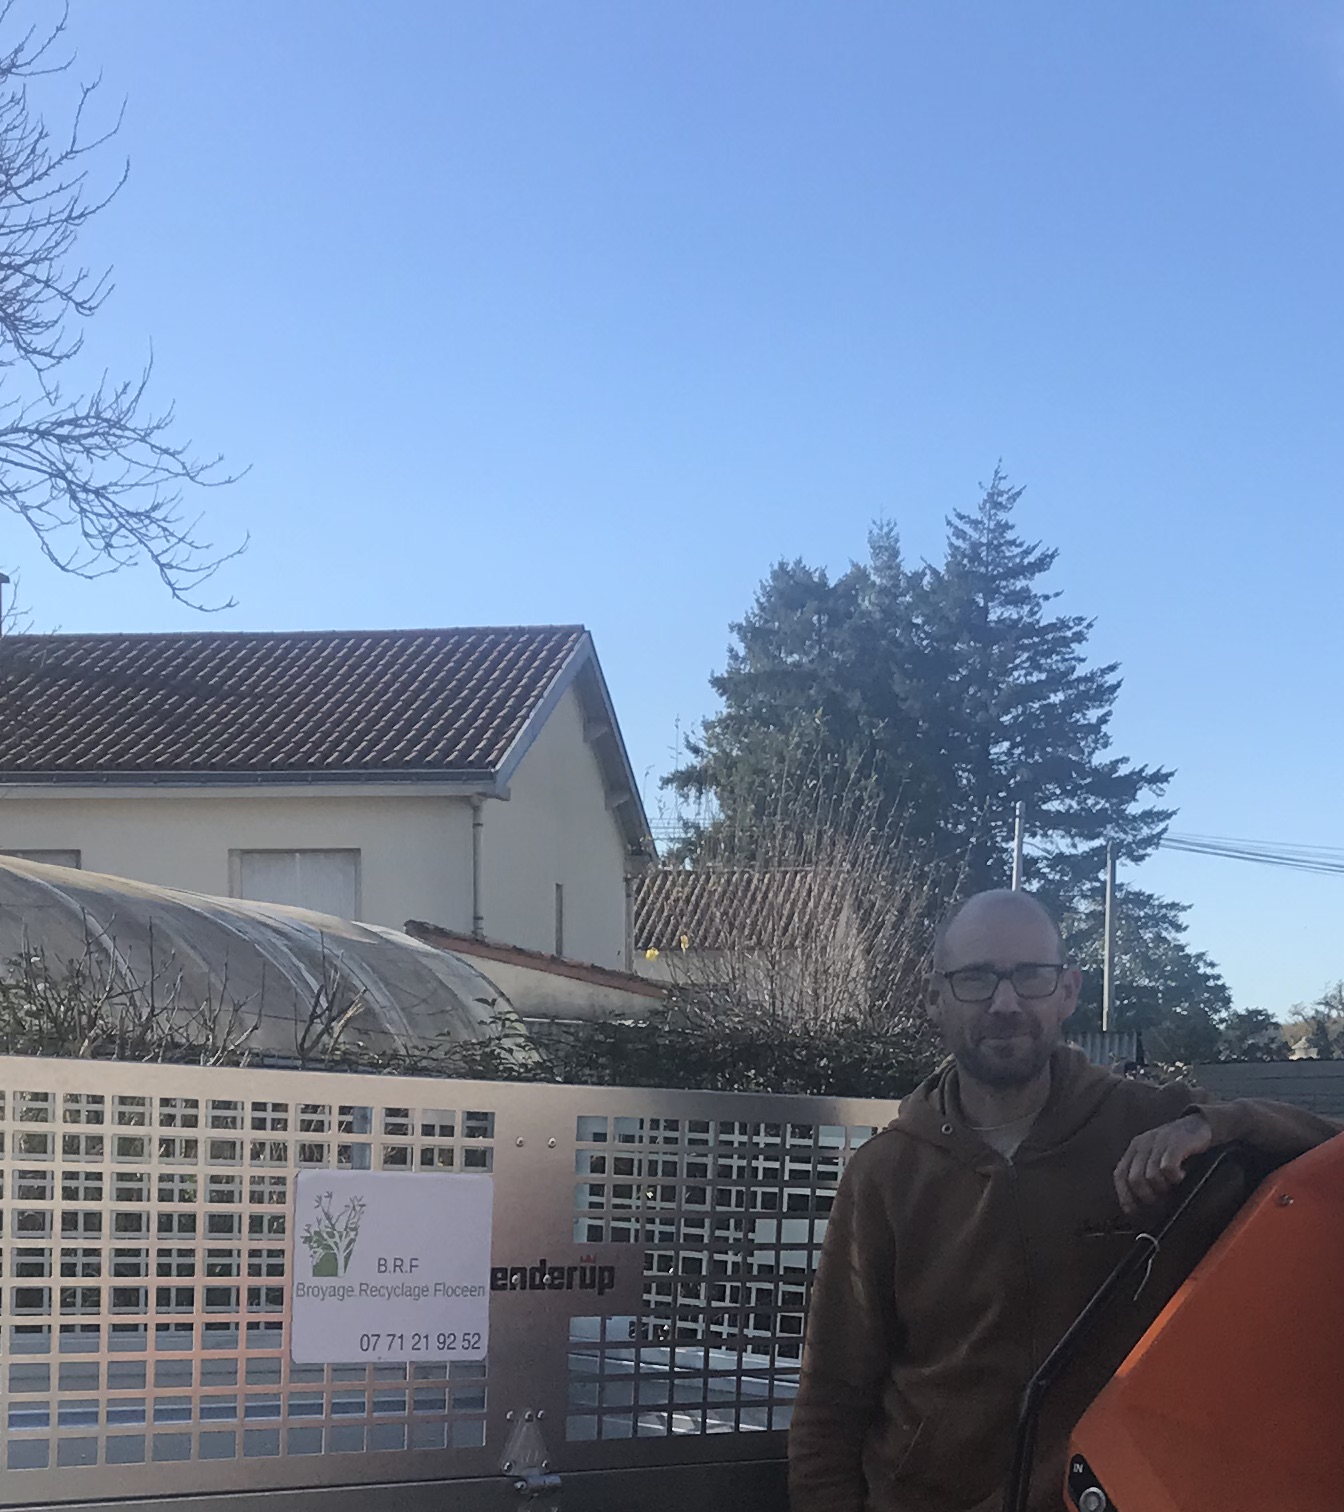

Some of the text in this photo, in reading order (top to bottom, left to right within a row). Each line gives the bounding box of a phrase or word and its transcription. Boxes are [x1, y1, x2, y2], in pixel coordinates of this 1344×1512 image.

[377, 1257, 419, 1274] B.R.F
[490, 1258, 615, 1295] enderup
[295, 1282, 486, 1301] Broyage Recyclage Floceen
[359, 1332, 482, 1352] 07 71 21 92 52
[1072, 1463, 1084, 1473] IN
